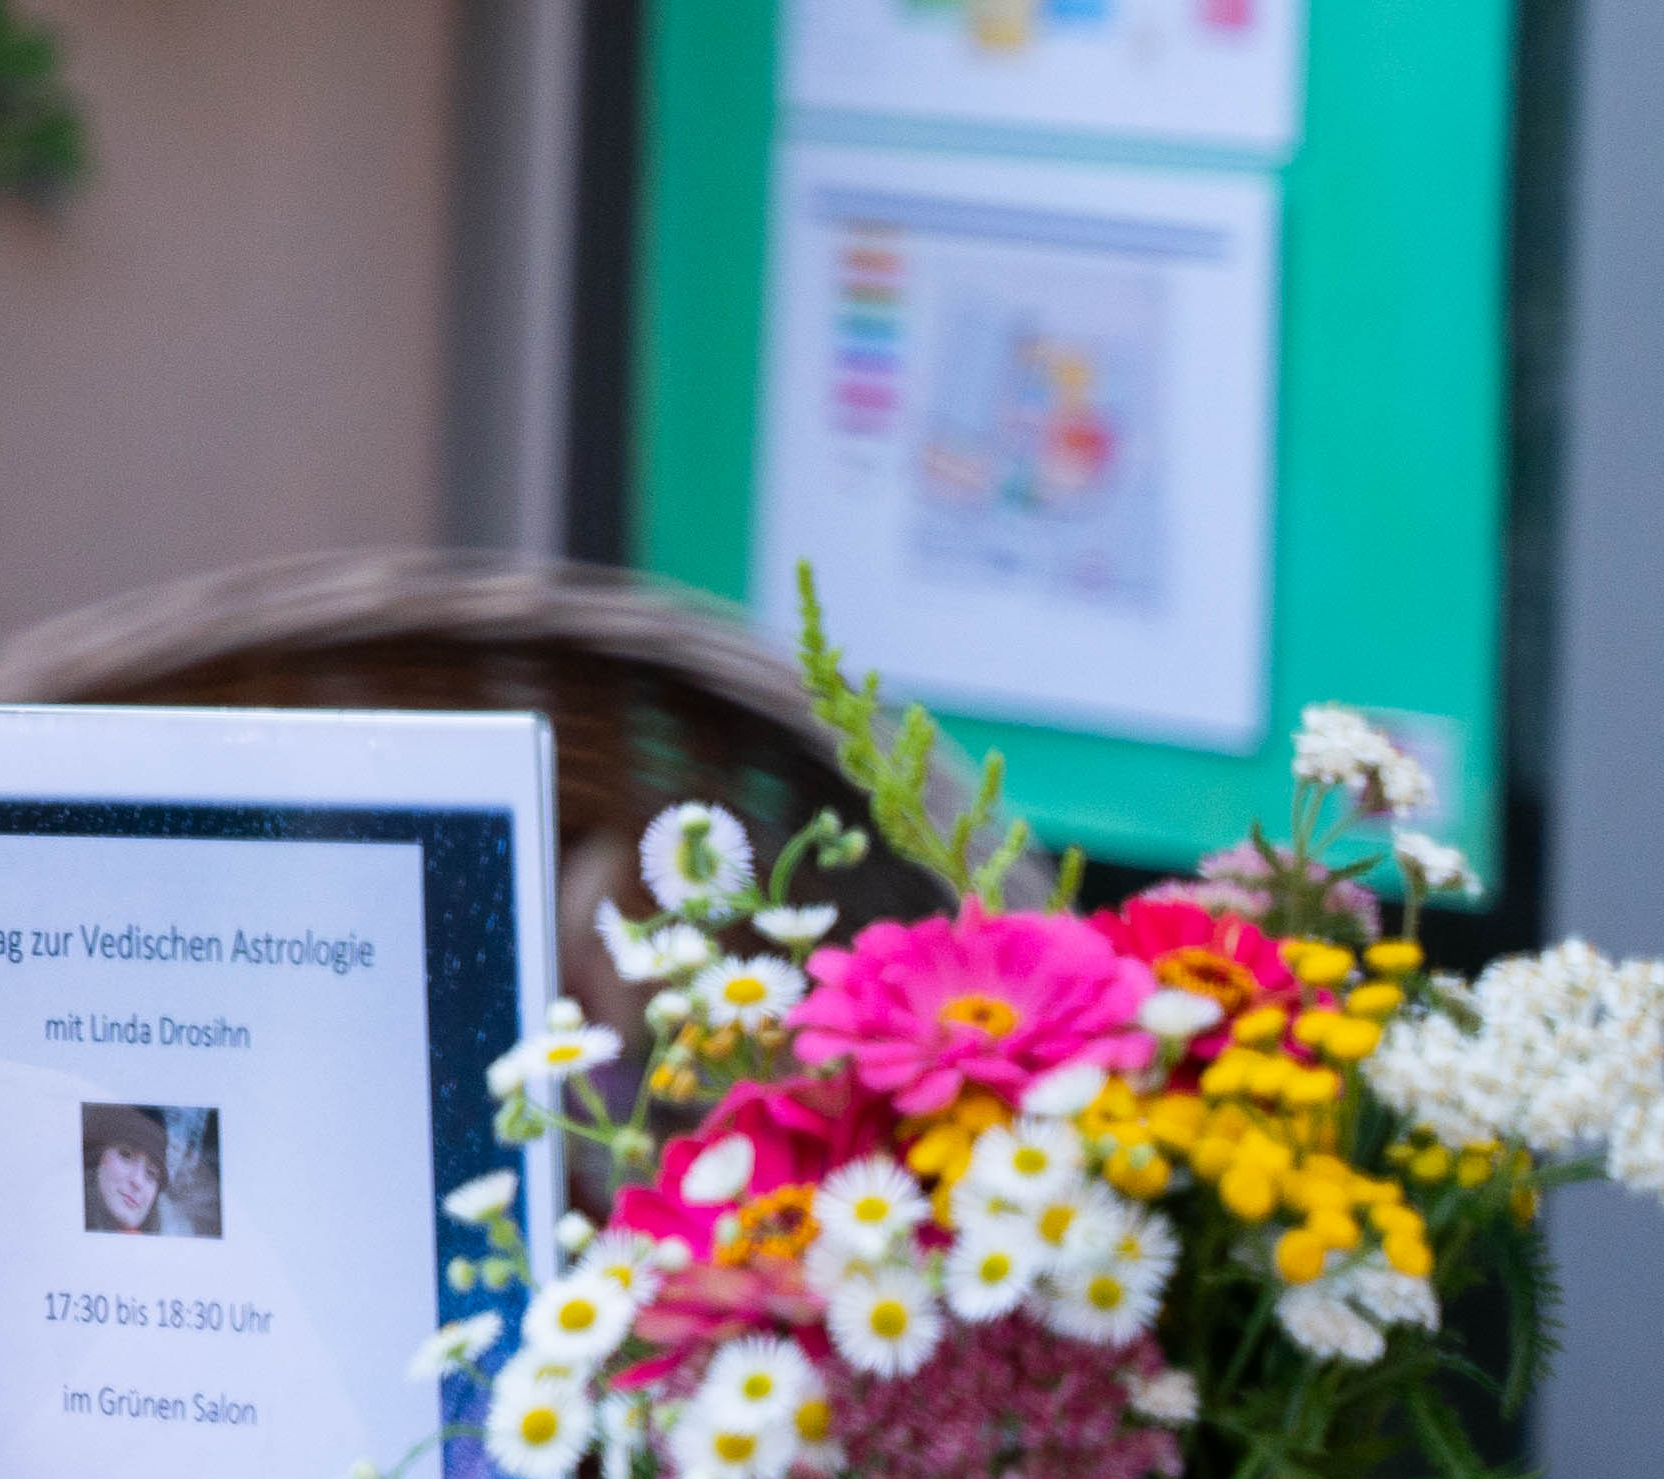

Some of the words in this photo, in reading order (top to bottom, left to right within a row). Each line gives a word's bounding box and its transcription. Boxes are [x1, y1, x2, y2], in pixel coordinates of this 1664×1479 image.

[31, 928, 74, 958] zur
[80, 922, 223, 963] Vedischen
[231, 928, 376, 975] Astrologie
[44, 1014, 84, 1043] mit
[89, 1014, 151, 1045] Linda
[160, 1017, 251, 1049] Drosihn
[45, 1292, 109, 1324] 17:30
[116, 1294, 149, 1327] bis
[157, 1299, 223, 1331] 18:30
[230, 1301, 273, 1334] Uhr
[62, 1384, 92, 1414] im
[98, 1386, 187, 1420] Grünen
[193, 1391, 259, 1425] Salon
